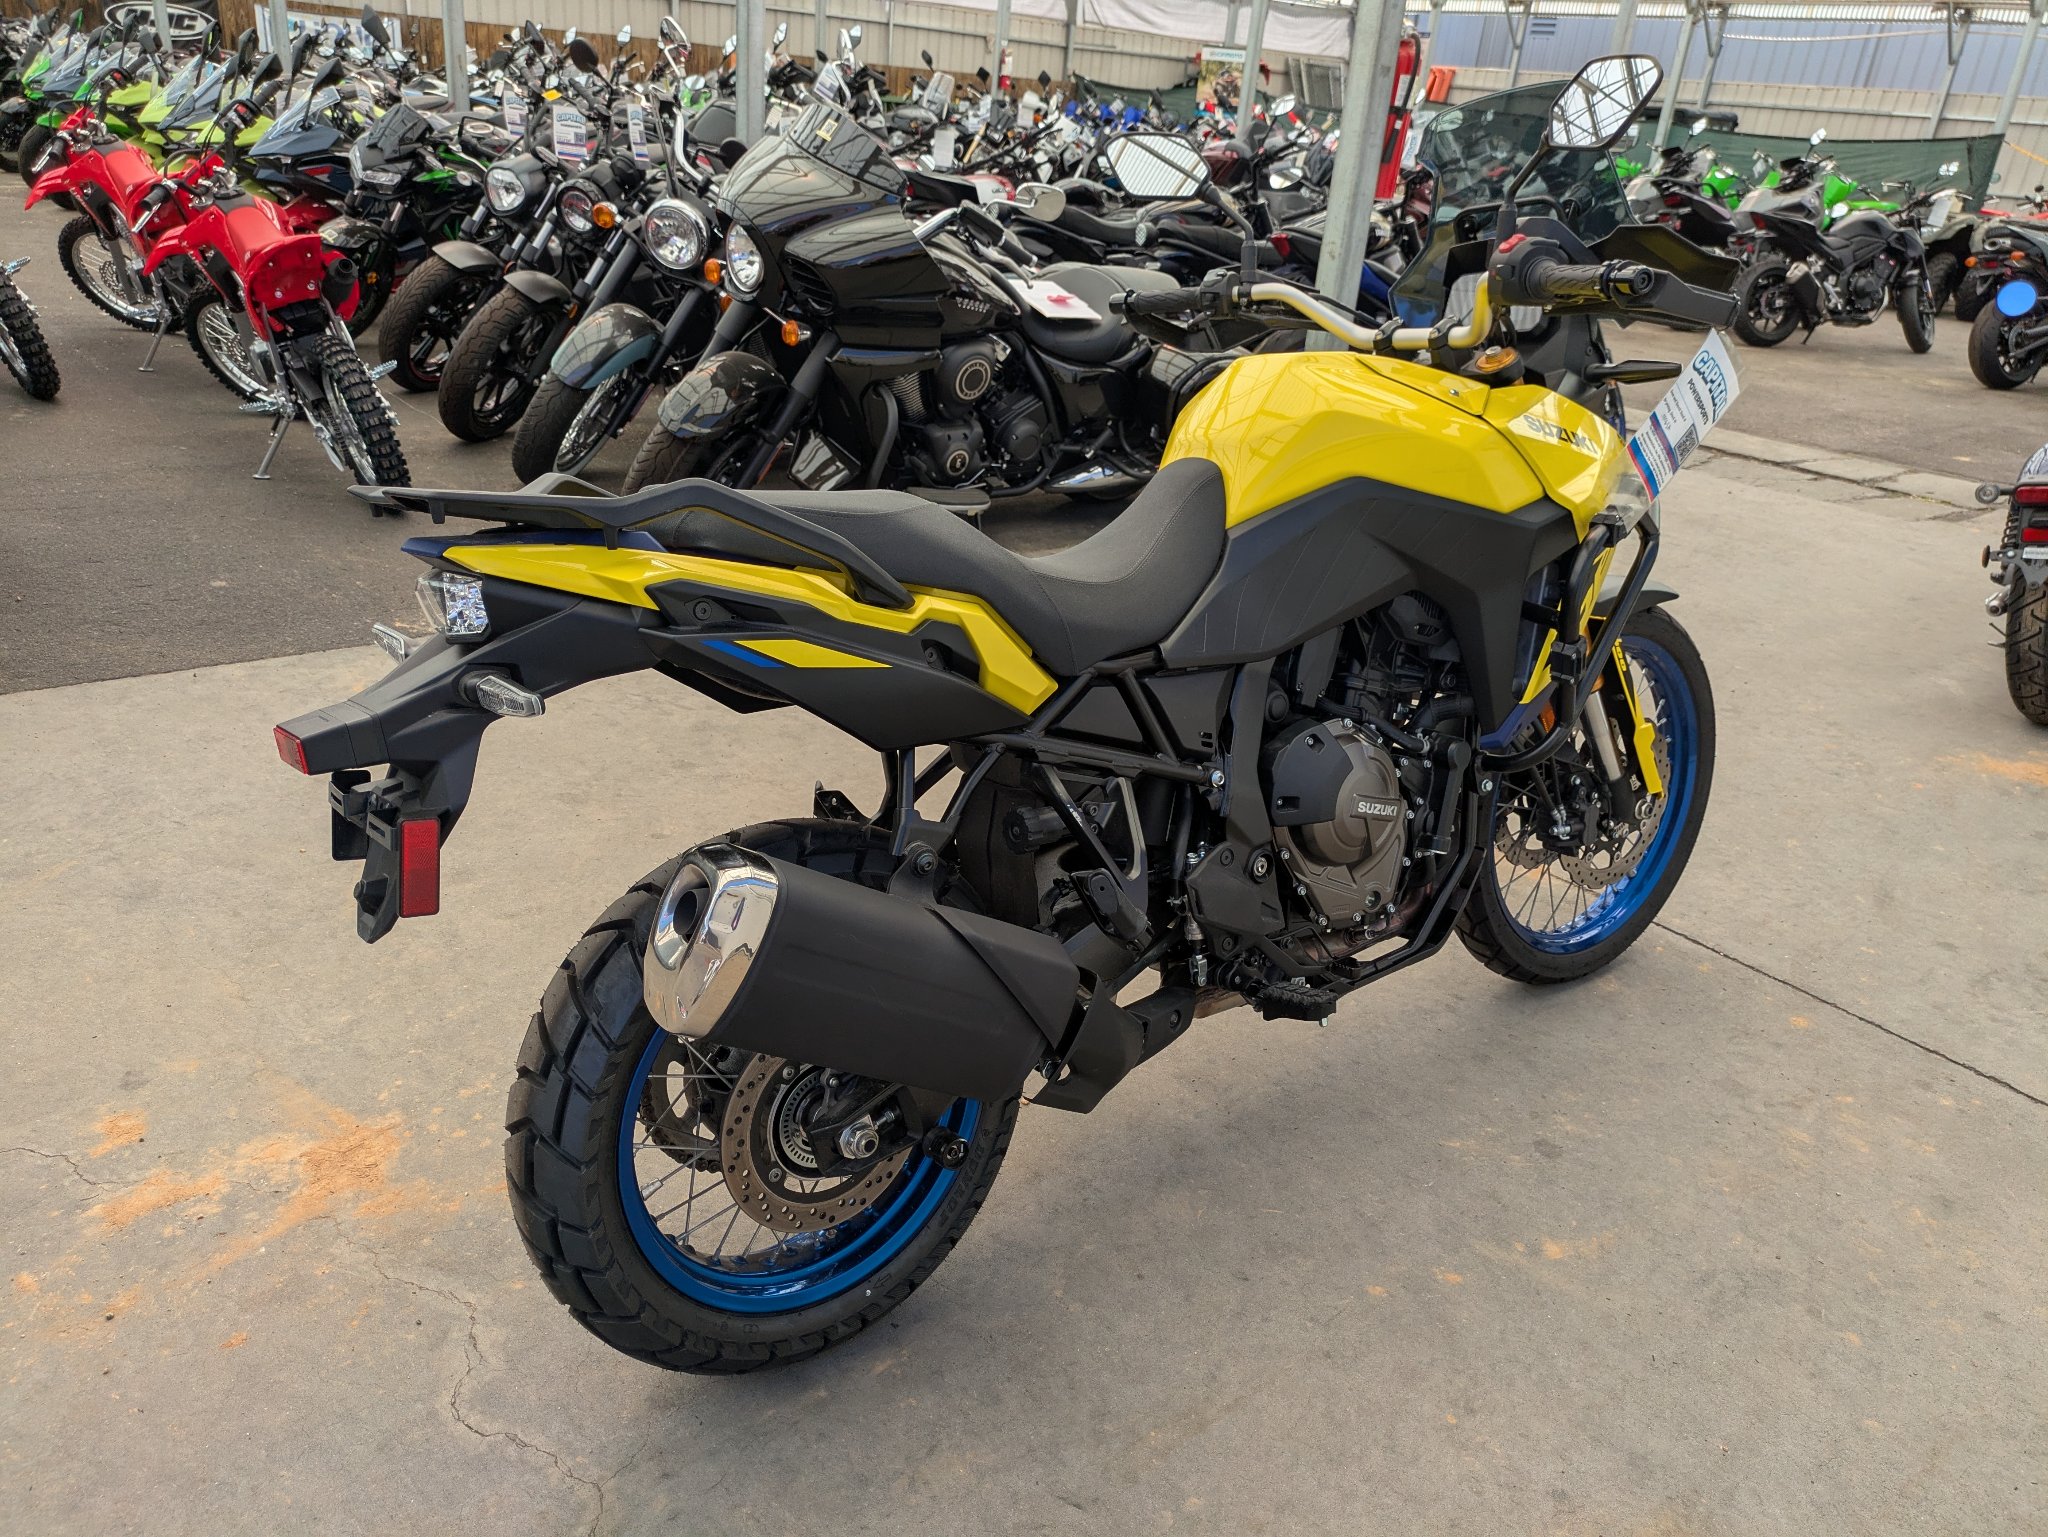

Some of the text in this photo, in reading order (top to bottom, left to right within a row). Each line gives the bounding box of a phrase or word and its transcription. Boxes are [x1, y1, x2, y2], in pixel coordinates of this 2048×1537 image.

[1687, 378, 1709, 425] POWERSPORTS
[1693, 350, 1728, 424] CAPITAL
[1523, 414, 1599, 456] SUZUKI
[1357, 801, 1398, 817] SUZUKI
